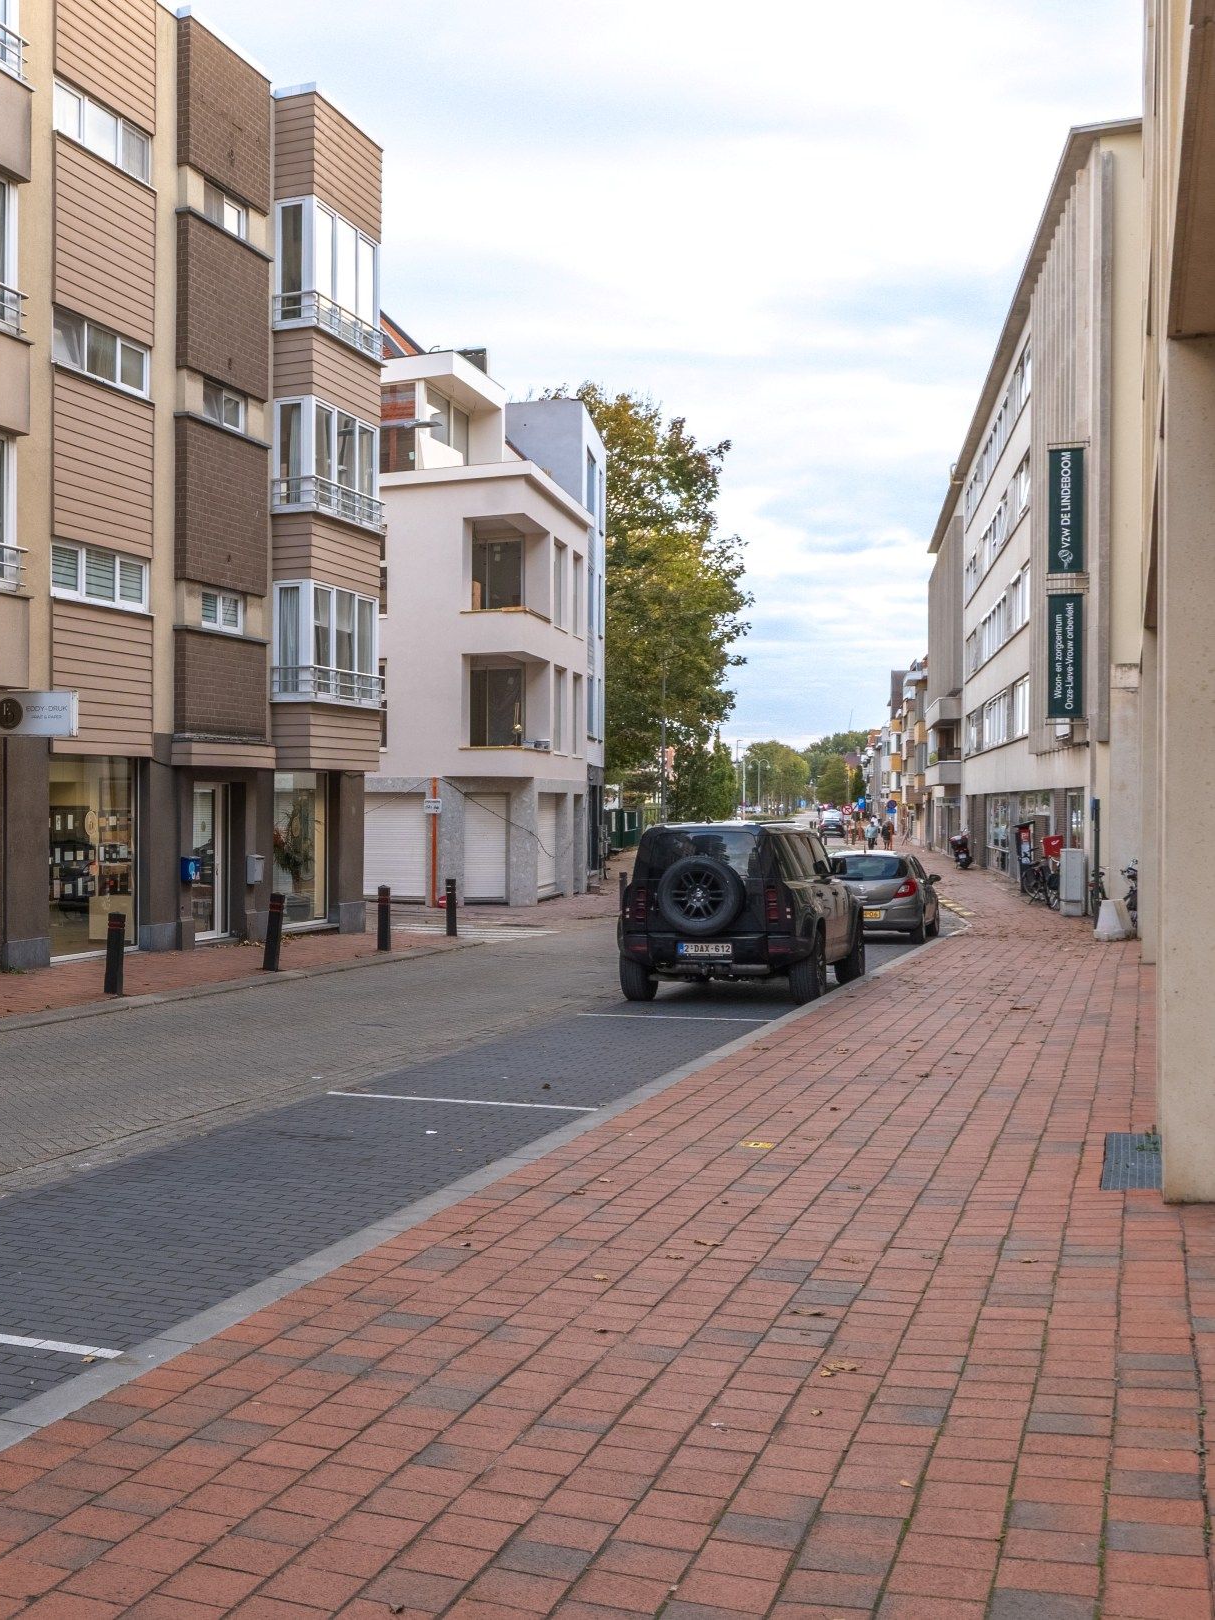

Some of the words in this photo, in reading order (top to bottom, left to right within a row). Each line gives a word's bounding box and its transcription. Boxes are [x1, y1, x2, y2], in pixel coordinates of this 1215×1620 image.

[1060, 451, 1072, 512] LINDEBOOM
[1060, 512, 1071, 526] DE
[1061, 527, 1071, 549] VZW
[1065, 602, 1074, 639] onbevlekt
[1055, 613, 1065, 661] zorgcentrum
[1055, 662, 1062, 673] en
[1065, 639, 1074, 710] Onze-Lieve-Vrouw
[1053, 673, 1062, 699] Woon-
[683, 944, 732, 953] 2-DAX-612
